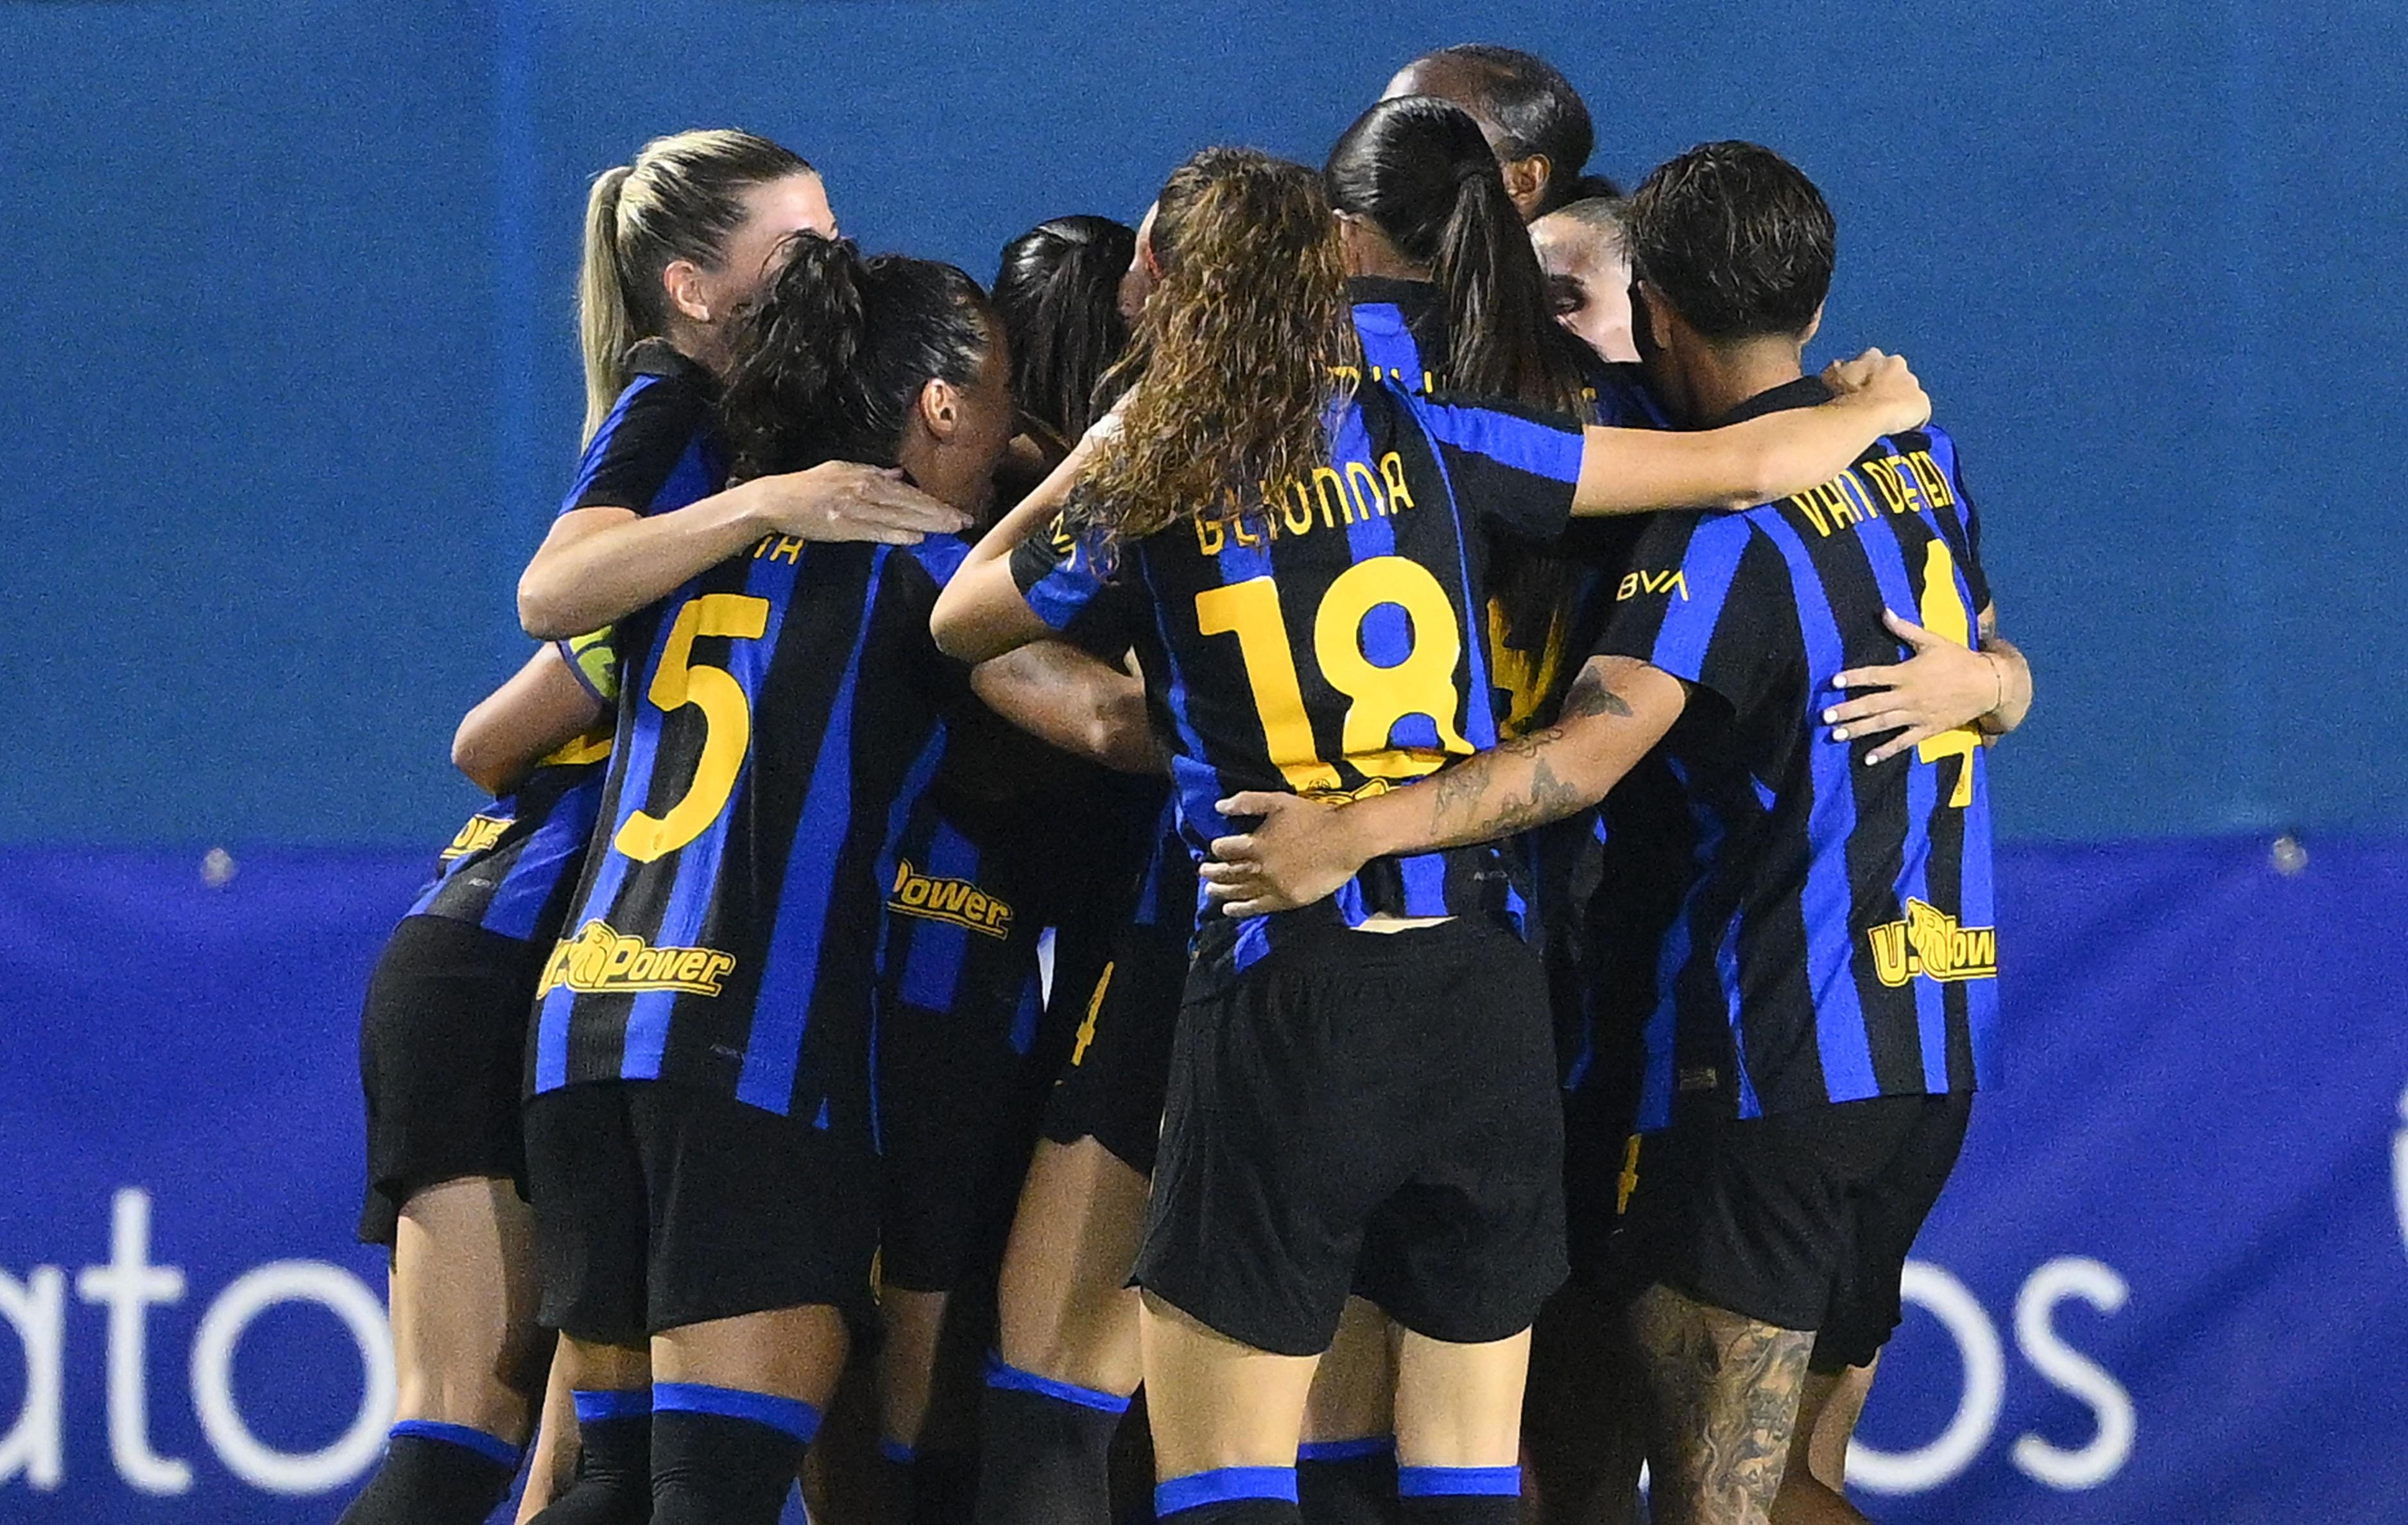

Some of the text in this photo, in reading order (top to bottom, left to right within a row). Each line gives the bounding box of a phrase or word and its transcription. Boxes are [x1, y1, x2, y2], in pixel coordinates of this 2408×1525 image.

[1791, 470, 1878, 537] VAN
[615, 594, 769, 863] 5
[1195, 556, 1475, 792] 18
